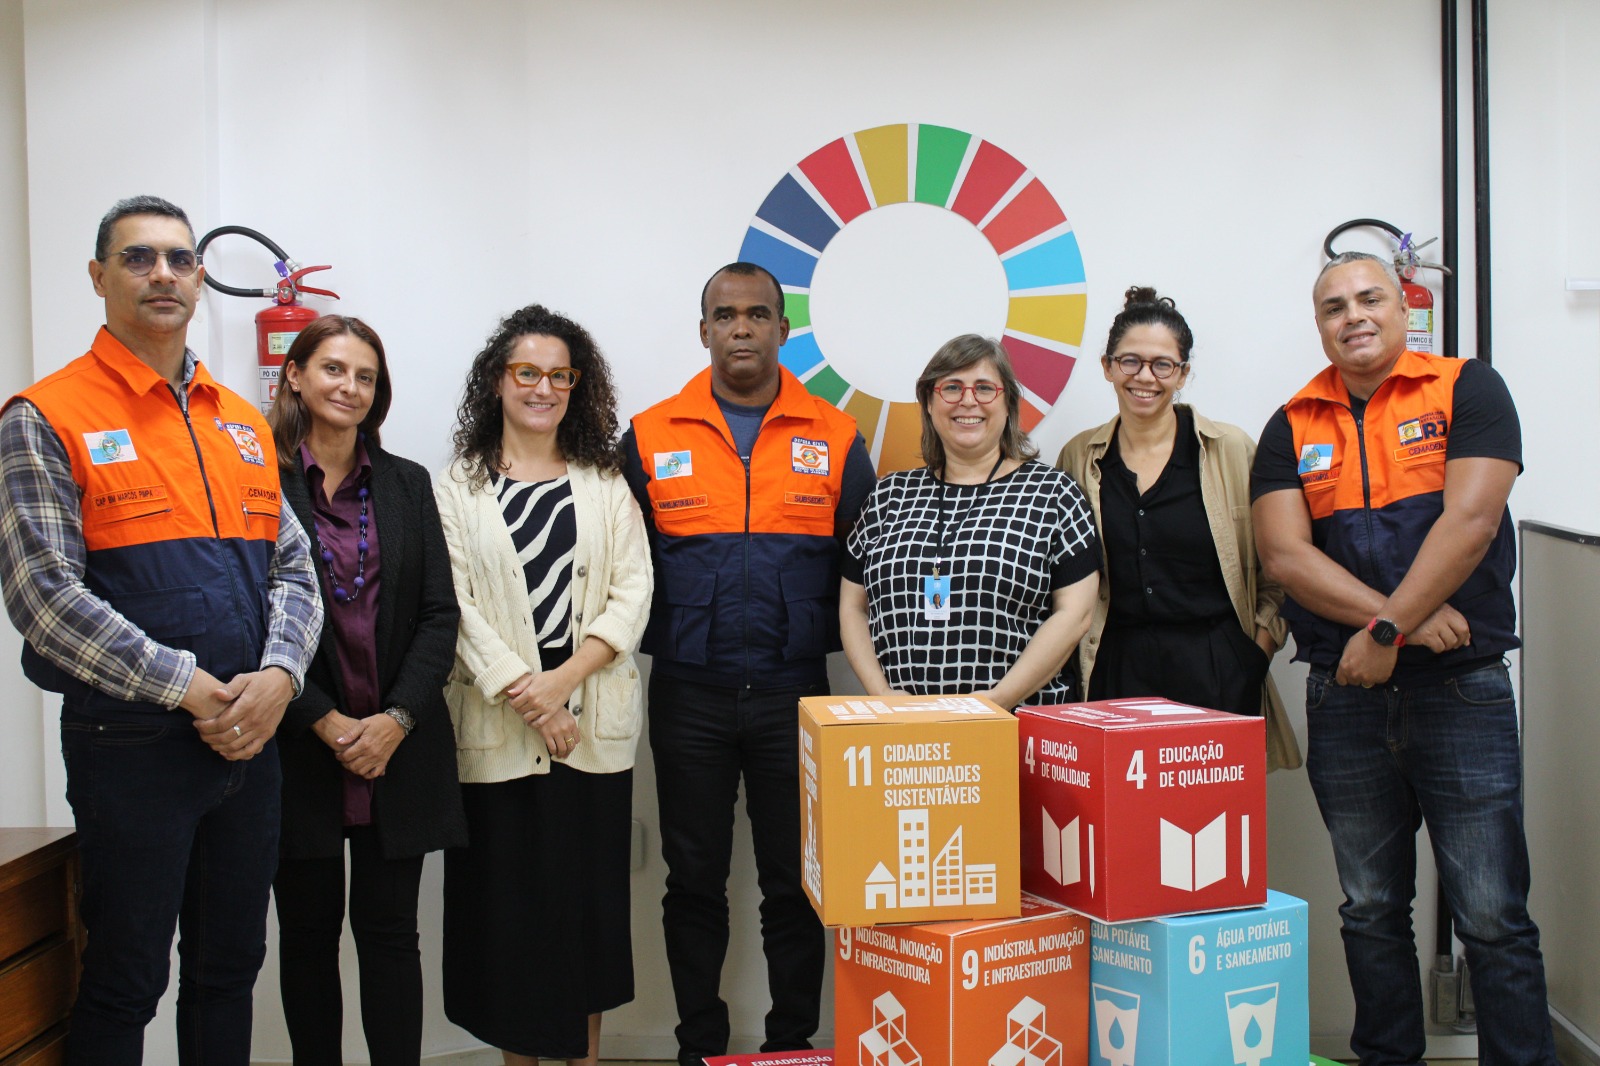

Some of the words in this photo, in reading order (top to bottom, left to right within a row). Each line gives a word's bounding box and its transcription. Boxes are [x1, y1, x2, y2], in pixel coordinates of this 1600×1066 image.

[1422, 420, 1448, 439] RJ
[1408, 442, 1444, 456] CEMADEN
[248, 488, 278, 501] CEMADEN
[884, 744, 940, 762] CIDADES
[944, 743, 950, 760] E
[1025, 736, 1036, 774] 4
[1042, 739, 1078, 763] EDUCAÇÃO
[1159, 740, 1223, 764] EDUCAÇÃO
[844, 746, 872, 786] 11
[884, 765, 980, 785] COMUNIDADES
[1042, 765, 1049, 778] DE
[1052, 766, 1090, 788] QUALIDADE
[1126, 750, 1147, 790] 4
[1160, 772, 1175, 788] DE
[1179, 766, 1244, 788] QUALIDADE
[884, 785, 980, 807] SUSTENTÁVEIS
[840, 927, 852, 960] 9
[856, 926, 898, 954] INDÚSTRIA,
[900, 938, 943, 965] INOVAÇÃO
[984, 939, 1036, 963] INDÚSTRIA,
[1039, 929, 1085, 958] INOVAÇÃO
[1091, 923, 1109, 941] GUA
[1112, 928, 1151, 951] POTÁVEL
[1217, 927, 1244, 948] ÁGUA
[1248, 920, 1290, 943] POTÁVEL
[856, 948, 860, 964] E
[862, 950, 930, 985] INFRAESTRUTURA
[1092, 946, 1152, 975] SANEAMENTO
[1189, 935, 1205, 974] 6
[1217, 955, 1222, 970] E
[1226, 942, 1291, 968] SANEAMENTO
[962, 950, 979, 990] 9
[984, 972, 990, 986] E
[992, 955, 1072, 984] INFRAESTRUTURA
[751, 1056, 832, 1066] ERRADICAÇÃO
